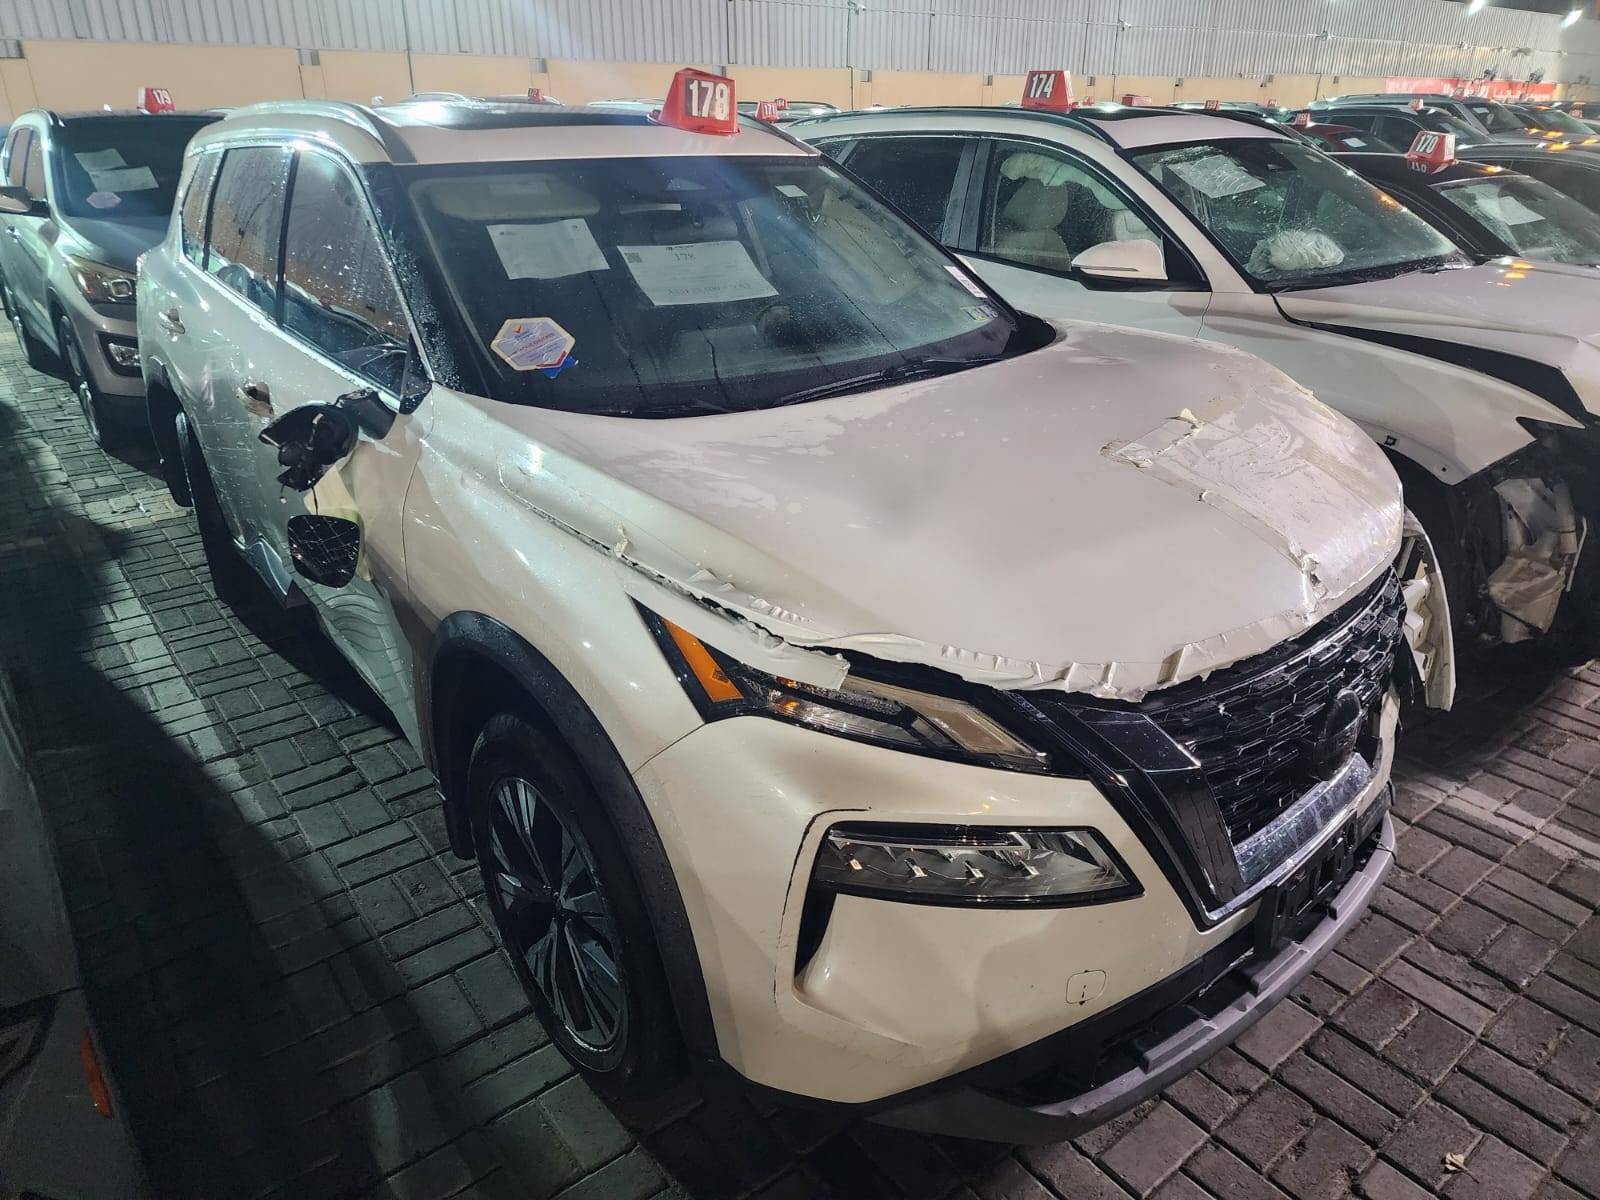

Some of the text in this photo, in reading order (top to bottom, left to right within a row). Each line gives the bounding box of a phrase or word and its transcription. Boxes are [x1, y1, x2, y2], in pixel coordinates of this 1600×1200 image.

[1029, 73, 1057, 98] 174
[152, 89, 172, 105] 179
[689, 79, 730, 121] 178
[1415, 134, 1439, 154] 170
